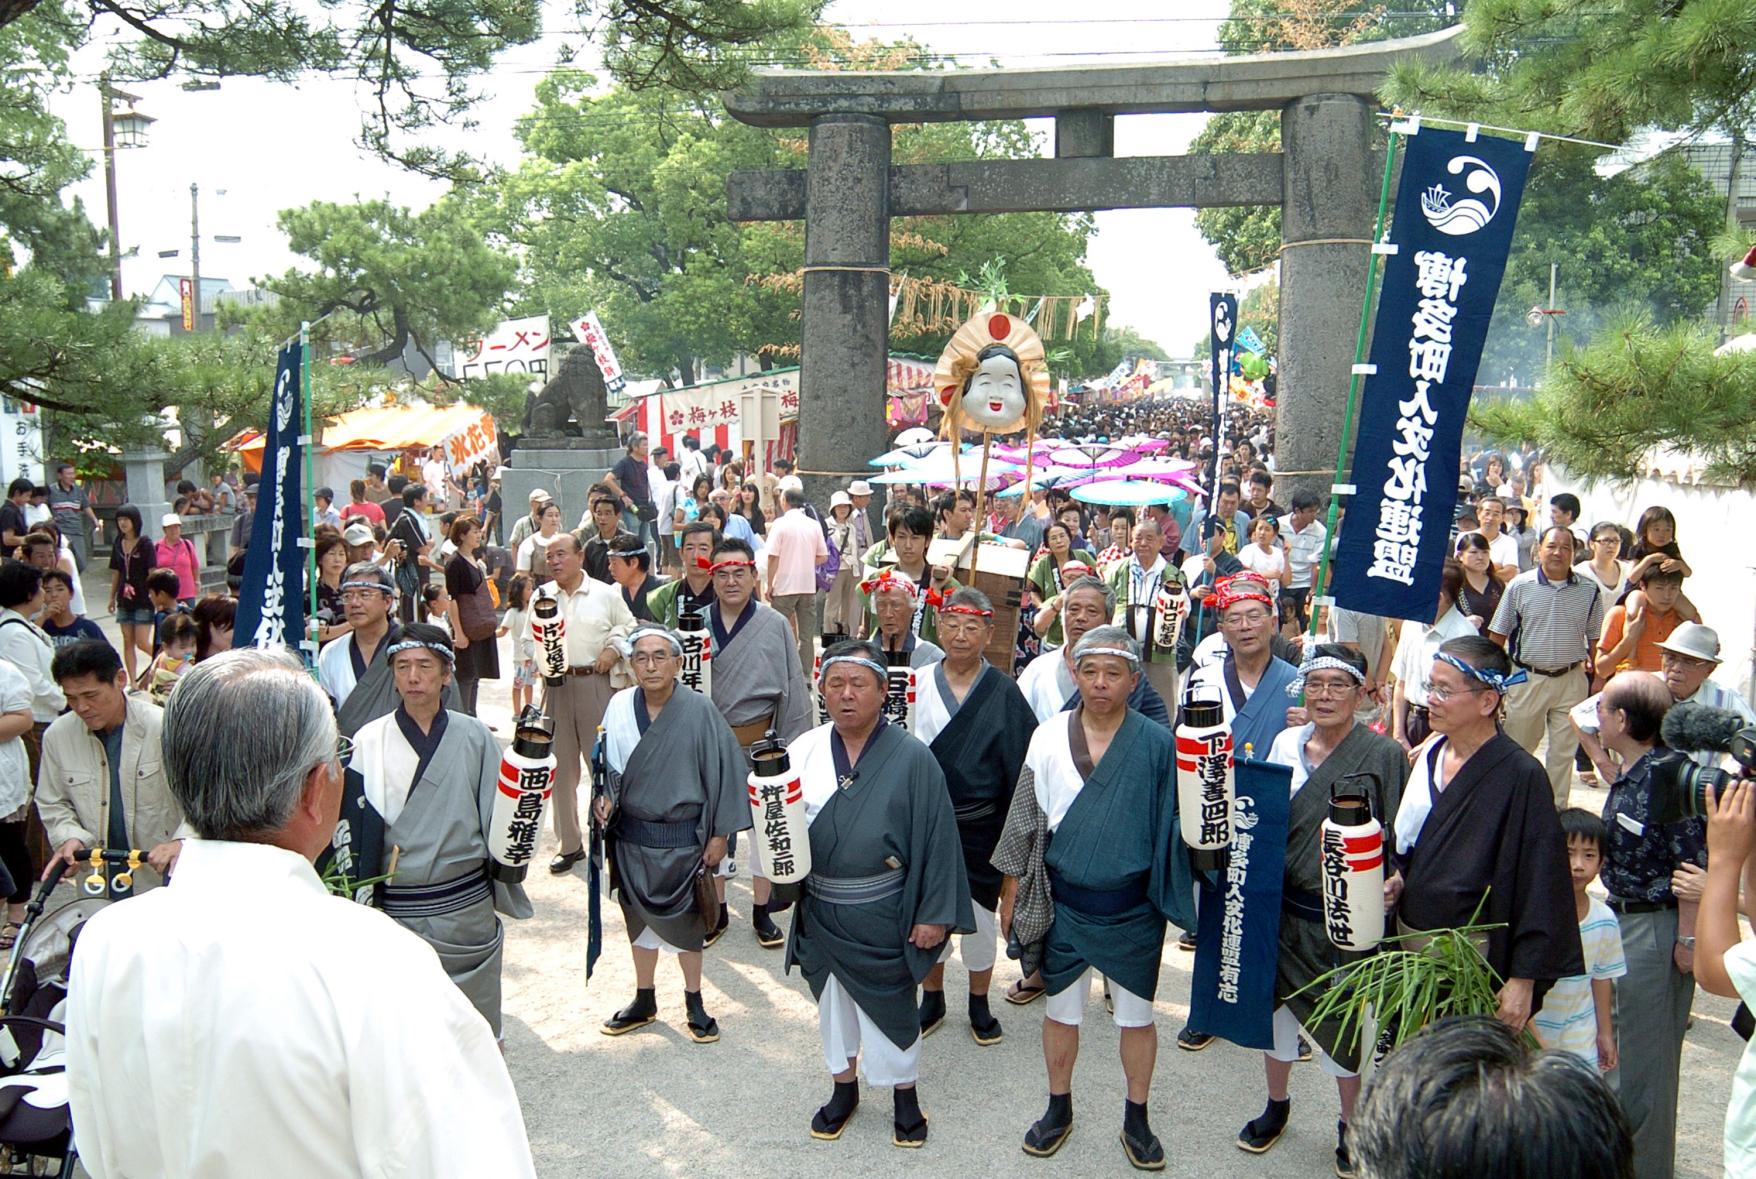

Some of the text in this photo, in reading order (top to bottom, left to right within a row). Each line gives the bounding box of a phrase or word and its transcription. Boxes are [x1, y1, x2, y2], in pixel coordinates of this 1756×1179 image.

[682, 634, 704, 694] 古川年
[503, 766, 551, 865] 西島雅幸
[1322, 826, 1356, 947] 長谷川法世
